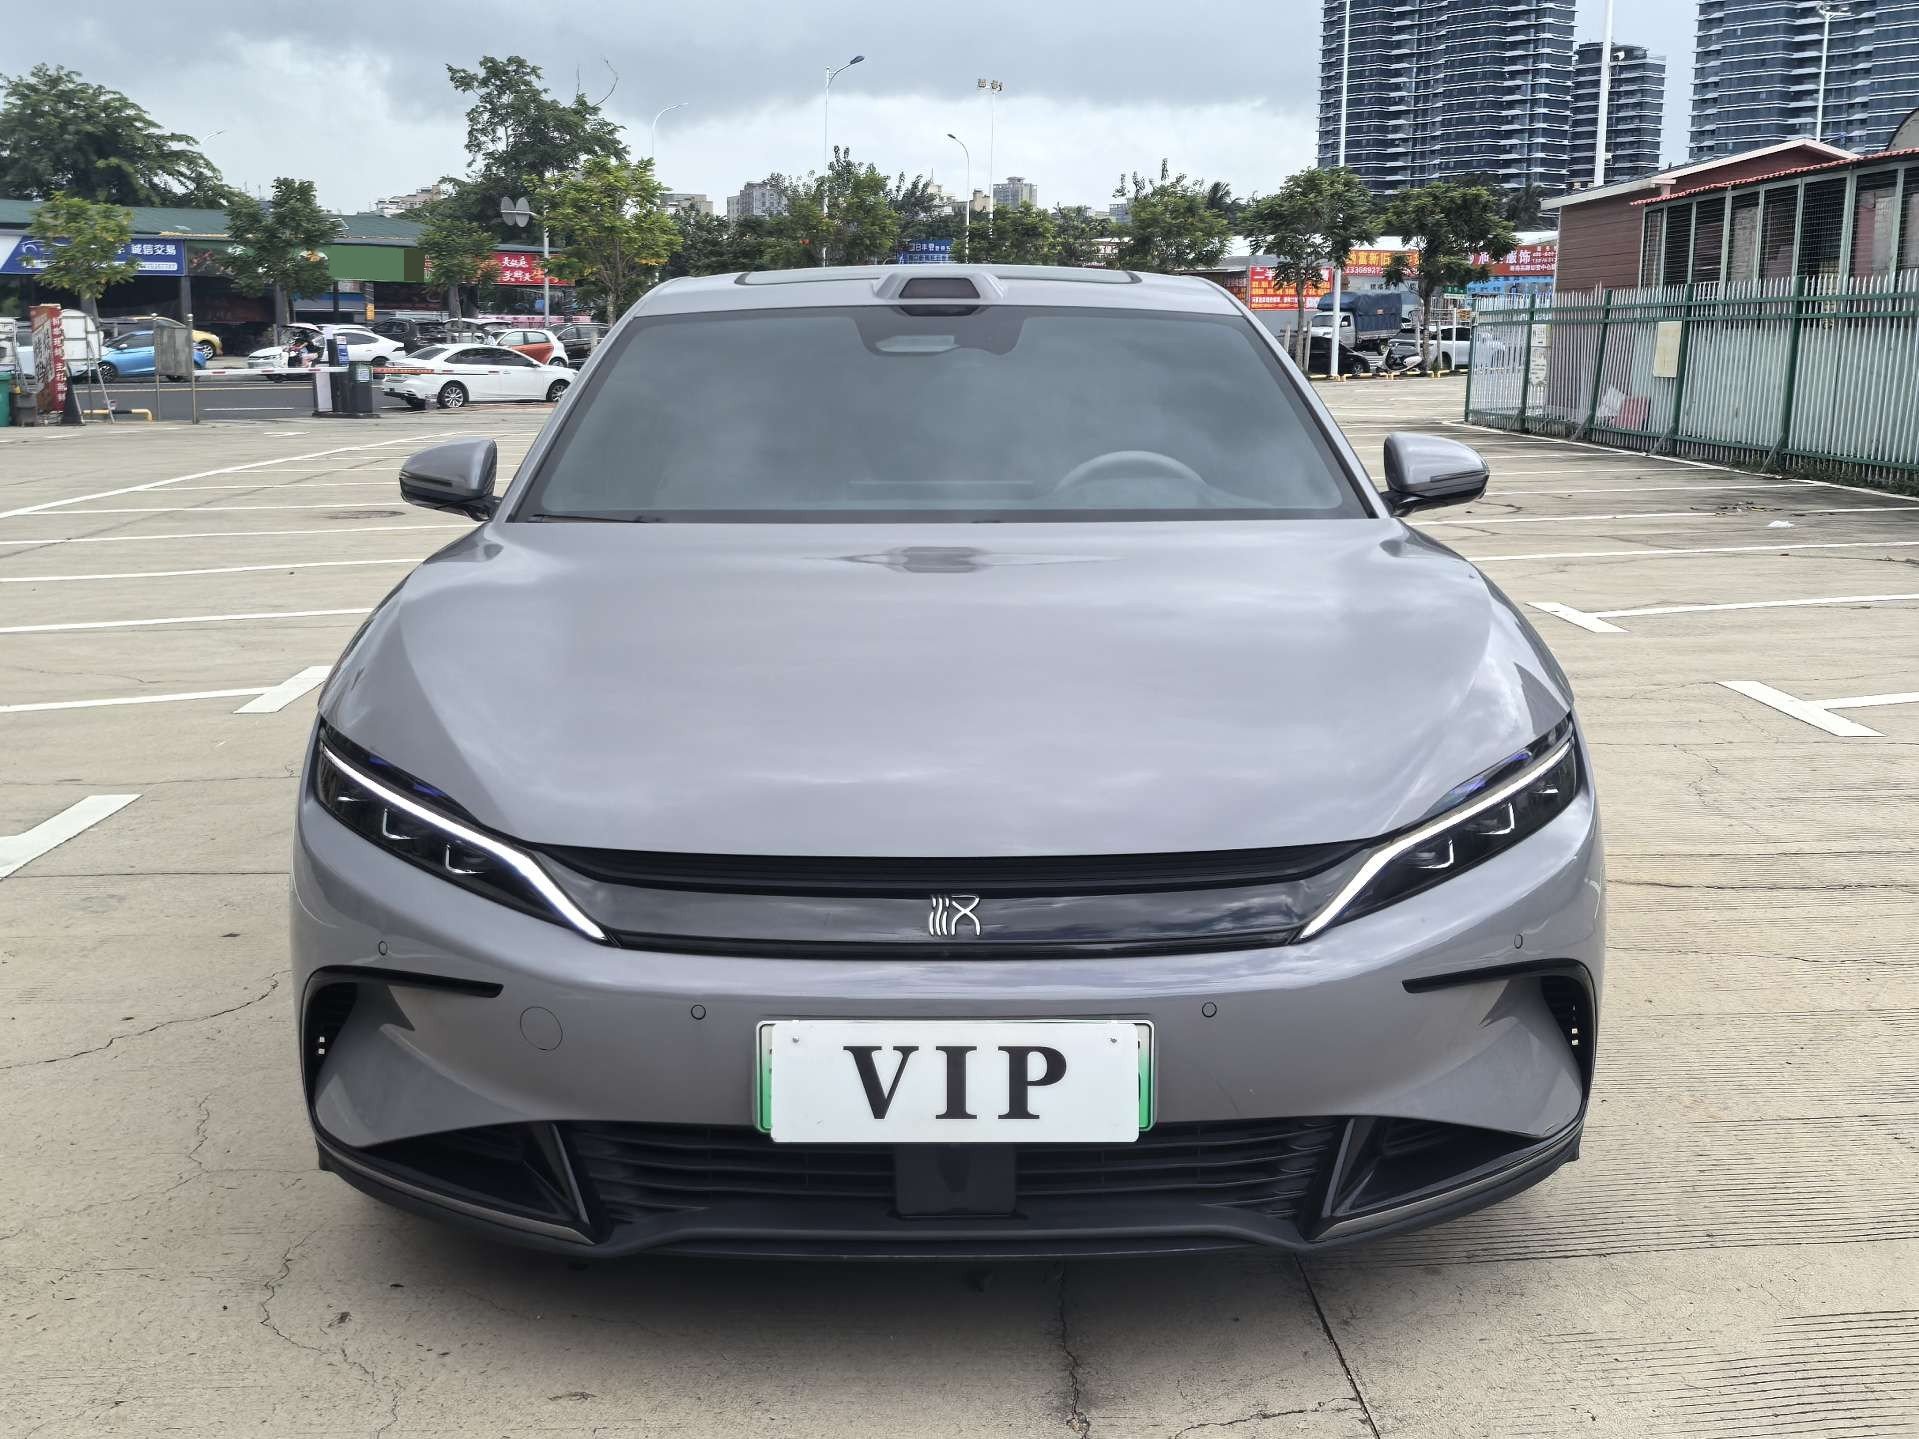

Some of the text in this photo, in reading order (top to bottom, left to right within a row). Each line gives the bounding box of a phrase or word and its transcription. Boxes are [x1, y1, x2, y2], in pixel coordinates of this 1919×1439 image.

[131, 244, 177, 255] 诚信交易
[843, 1045, 1067, 1120] VIP
